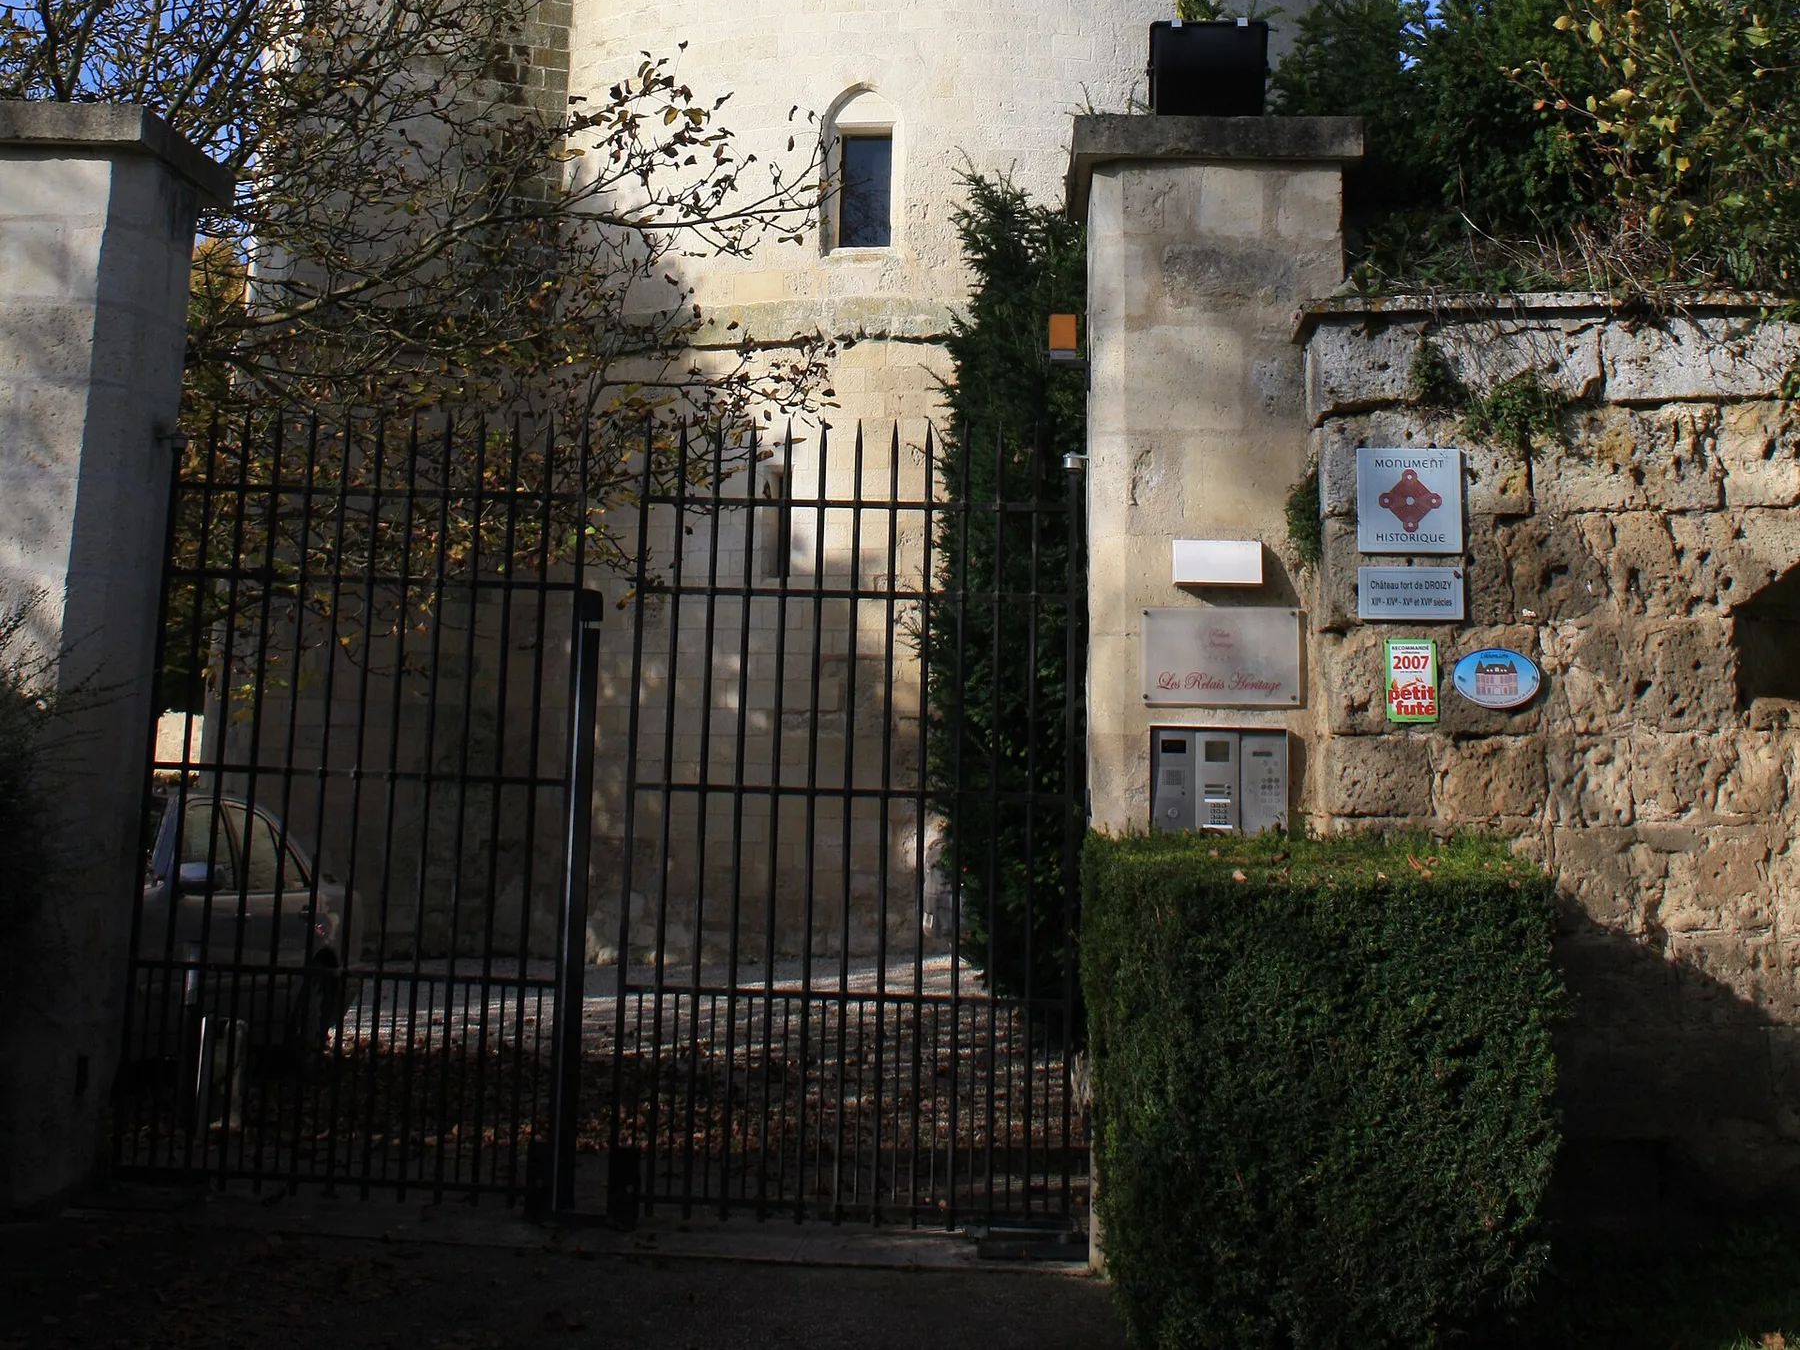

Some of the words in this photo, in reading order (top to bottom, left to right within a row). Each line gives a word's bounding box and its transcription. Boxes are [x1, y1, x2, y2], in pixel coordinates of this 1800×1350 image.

[1374, 459, 1444, 468] MONUMENT
[1376, 533, 1445, 543] HISTORIQUE
[1370, 580, 1398, 590] Château
[1400, 581, 1412, 590] fort
[1414, 581, 1422, 590] de
[1424, 581, 1452, 590] DROIZY
[1414, 598, 1420, 606] et
[1393, 656, 1429, 669] 2007
[1156, 672, 1180, 690] Les
[1184, 672, 1224, 690] Relais
[1228, 672, 1282, 698] Heritage
[1388, 684, 1435, 704] petit
[1396, 700, 1436, 715] futé
